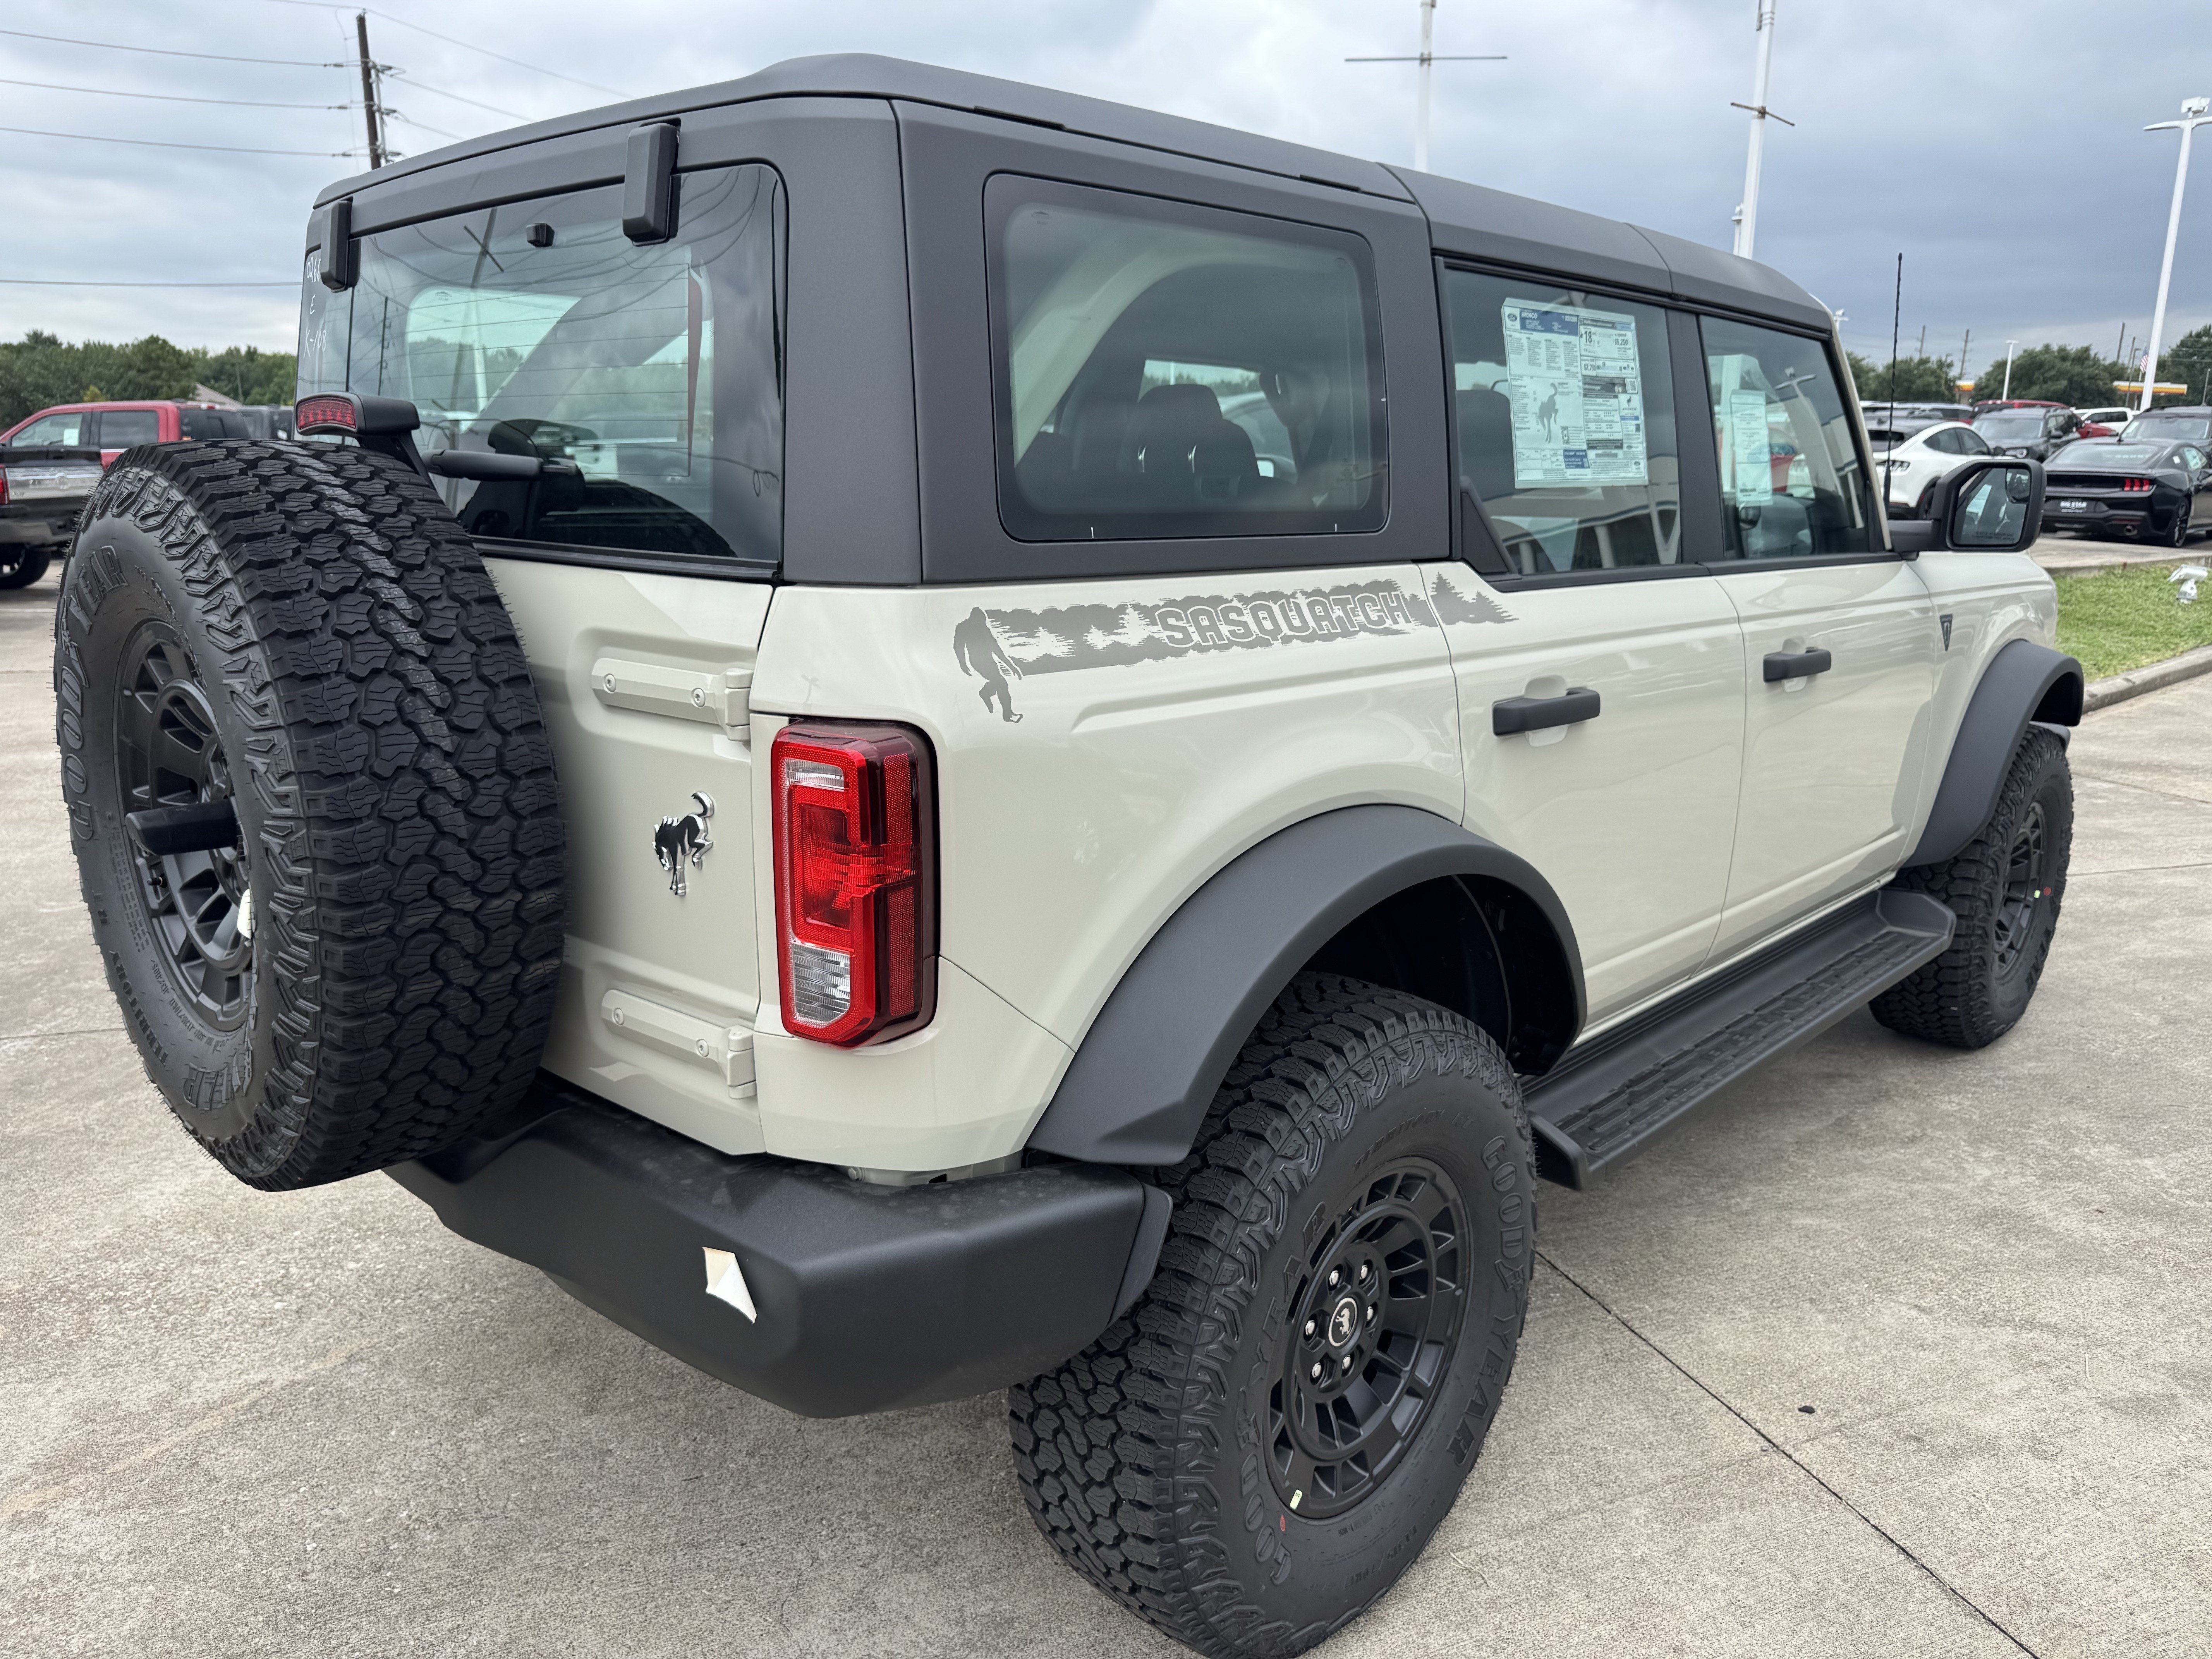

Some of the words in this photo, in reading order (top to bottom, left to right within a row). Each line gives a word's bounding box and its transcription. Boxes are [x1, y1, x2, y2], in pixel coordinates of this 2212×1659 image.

[1584, 331, 1592, 344] 18
[1155, 592, 1413, 647] SASQUATCH
[1446, 1135, 1524, 1465] GOODYEAR
